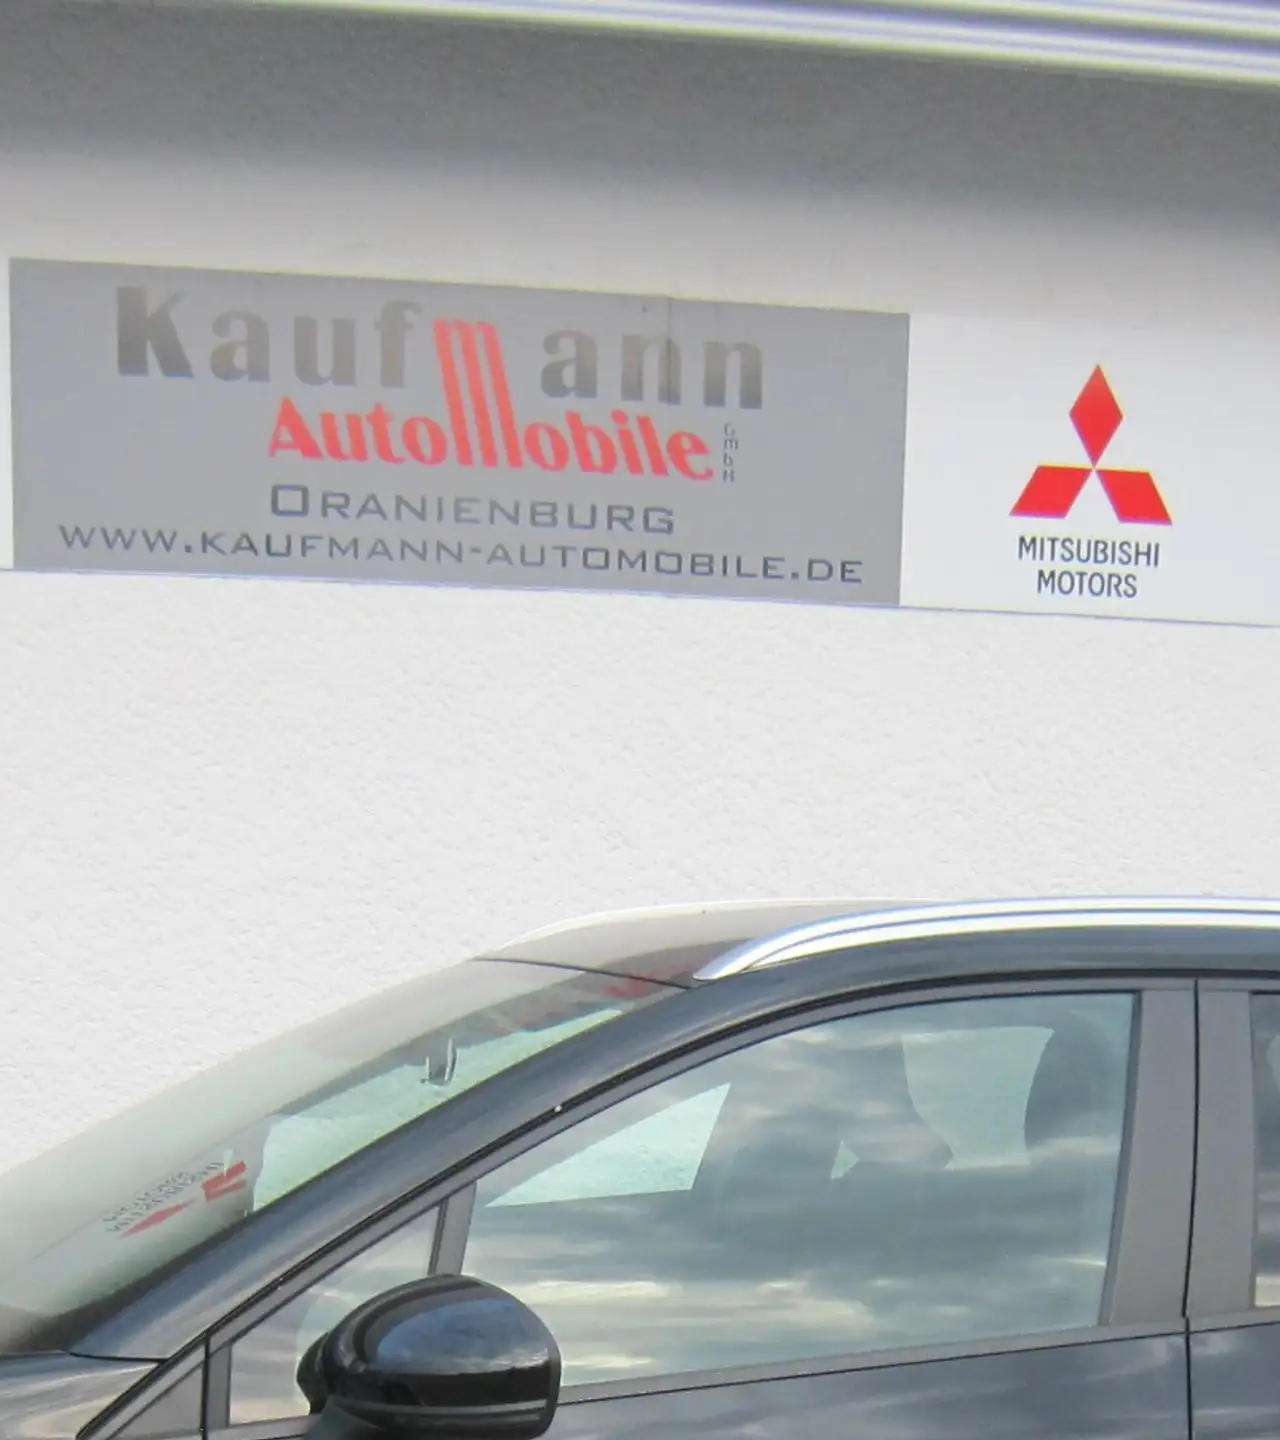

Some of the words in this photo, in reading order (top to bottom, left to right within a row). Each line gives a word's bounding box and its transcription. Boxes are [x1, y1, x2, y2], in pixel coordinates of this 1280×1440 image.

[117, 286, 763, 411] Kaufmann
[270, 484, 675, 536] ORANIENBURG
[1017, 535, 1160, 569] MITSUBISHI
[1036, 569, 1138, 599] MOTORS
